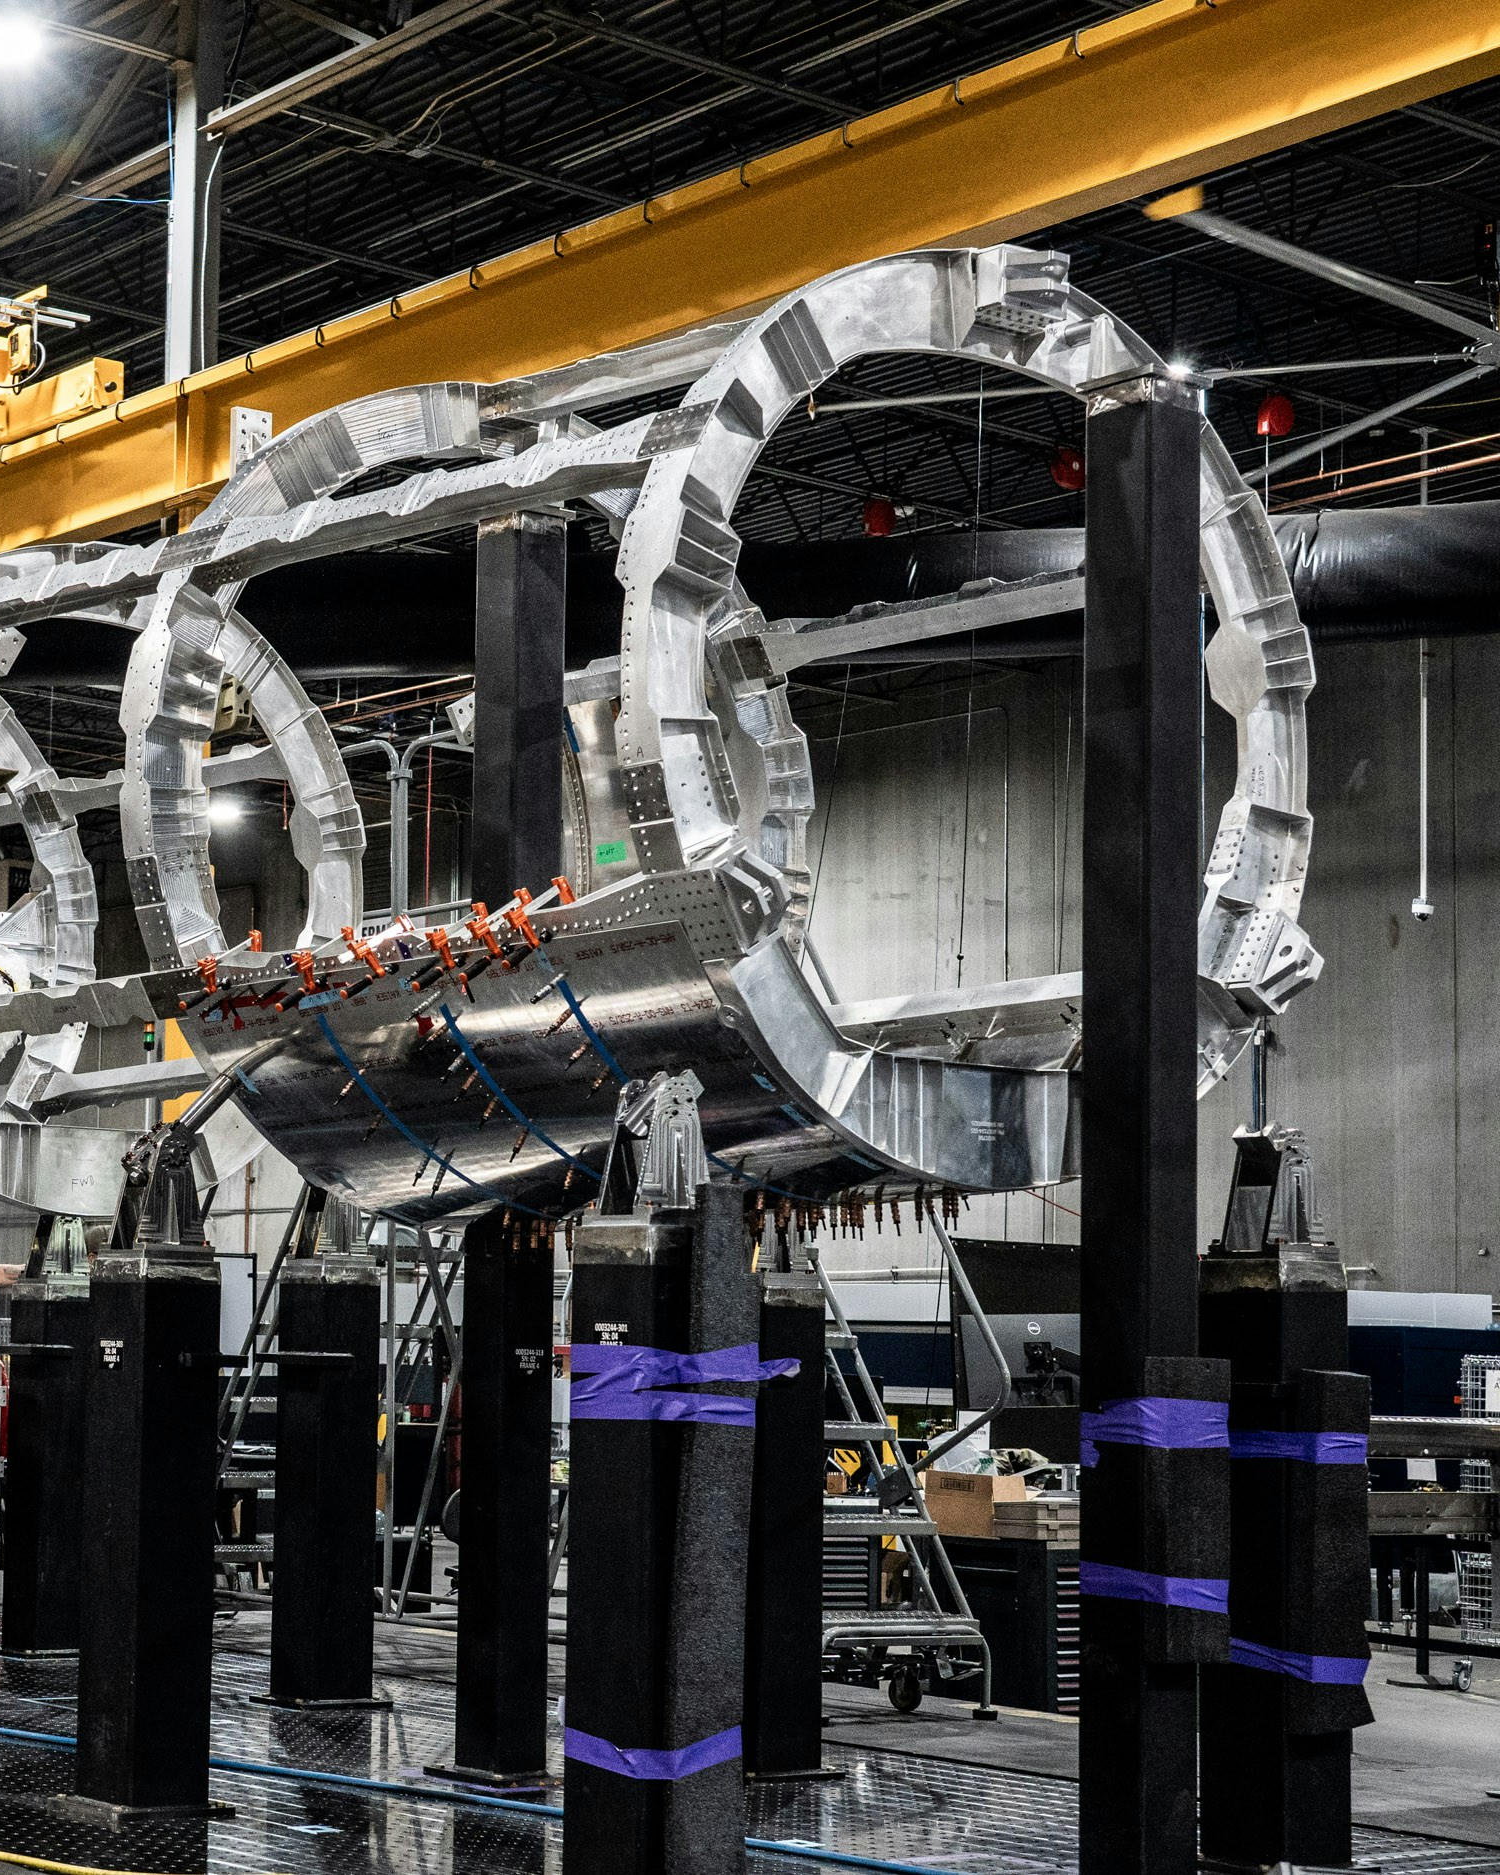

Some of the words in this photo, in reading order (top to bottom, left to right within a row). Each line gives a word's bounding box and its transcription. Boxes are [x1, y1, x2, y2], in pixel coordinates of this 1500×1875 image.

[71, 1174, 95, 1192] FWD
[594, 1322, 629, 1332] 0003244-301
[601, 1331, 611, 1340] SN:
[611, 1331, 619, 1340] 04
